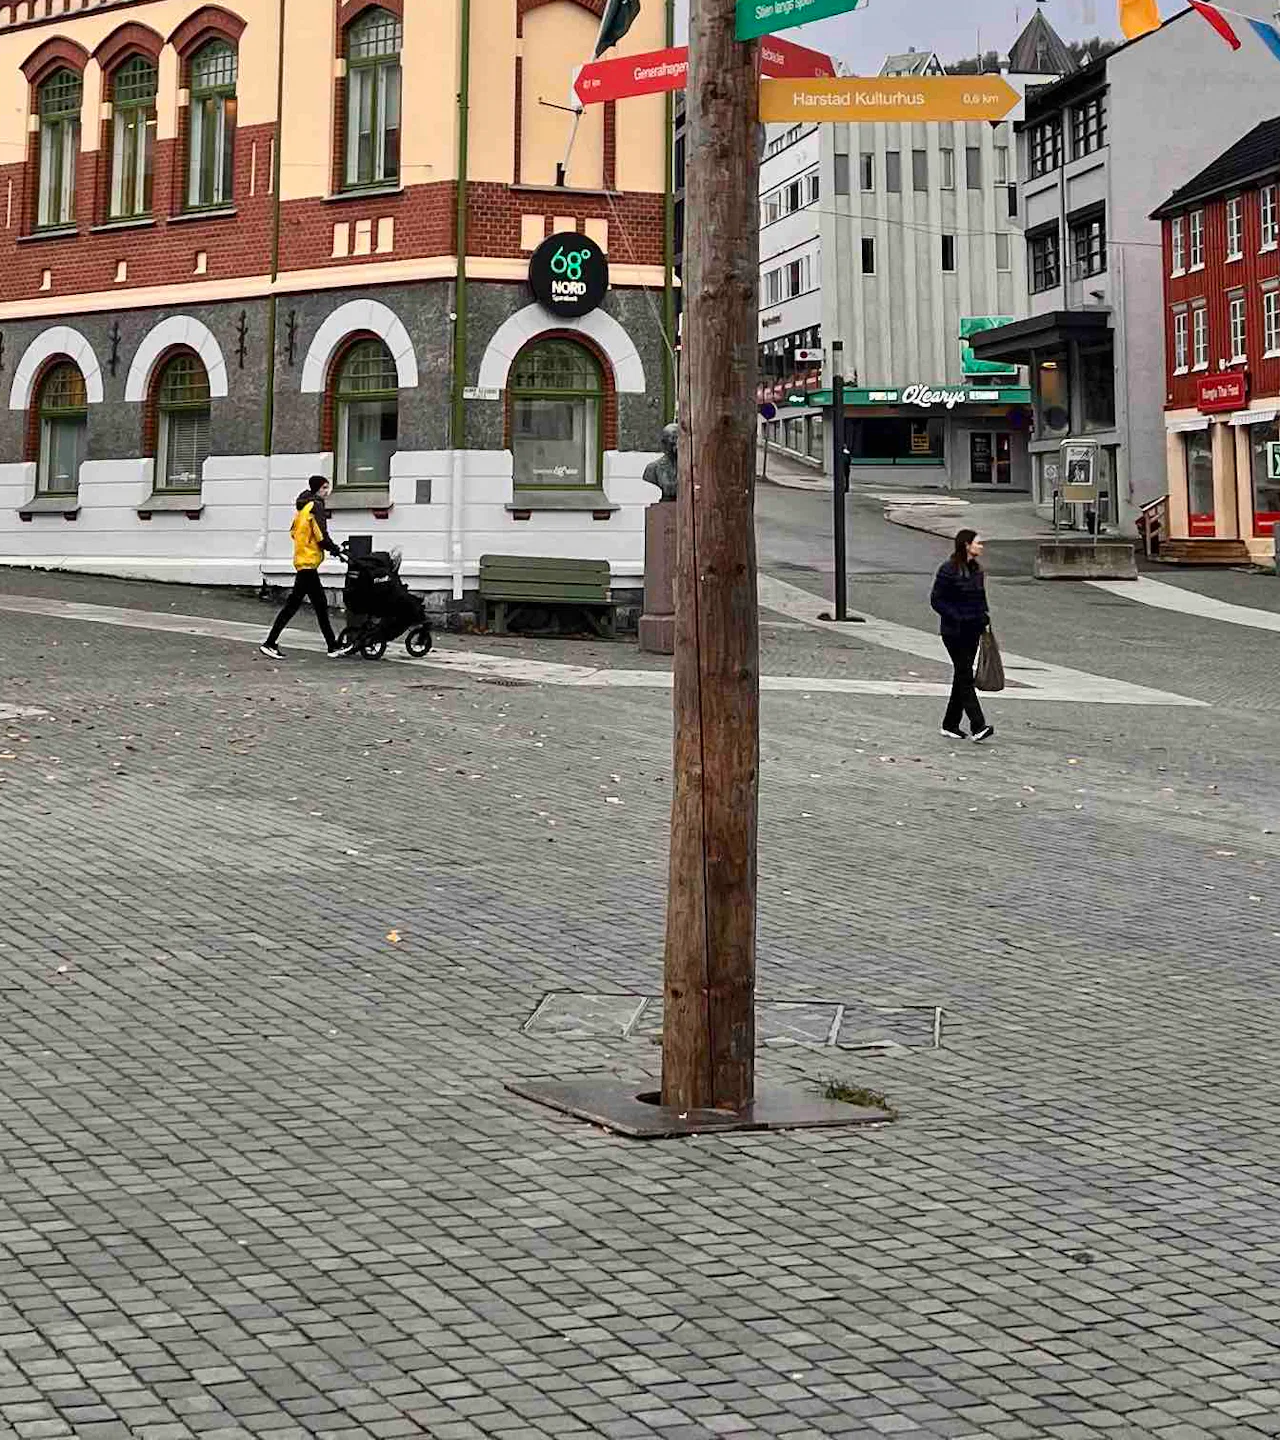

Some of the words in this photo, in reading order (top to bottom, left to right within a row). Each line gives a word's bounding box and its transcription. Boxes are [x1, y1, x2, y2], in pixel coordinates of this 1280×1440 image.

[793, 91, 851, 107] Harstad
[855, 91, 926, 106] Kulturhus
[982, 93, 999, 104] km
[551, 280, 587, 295] NORD
